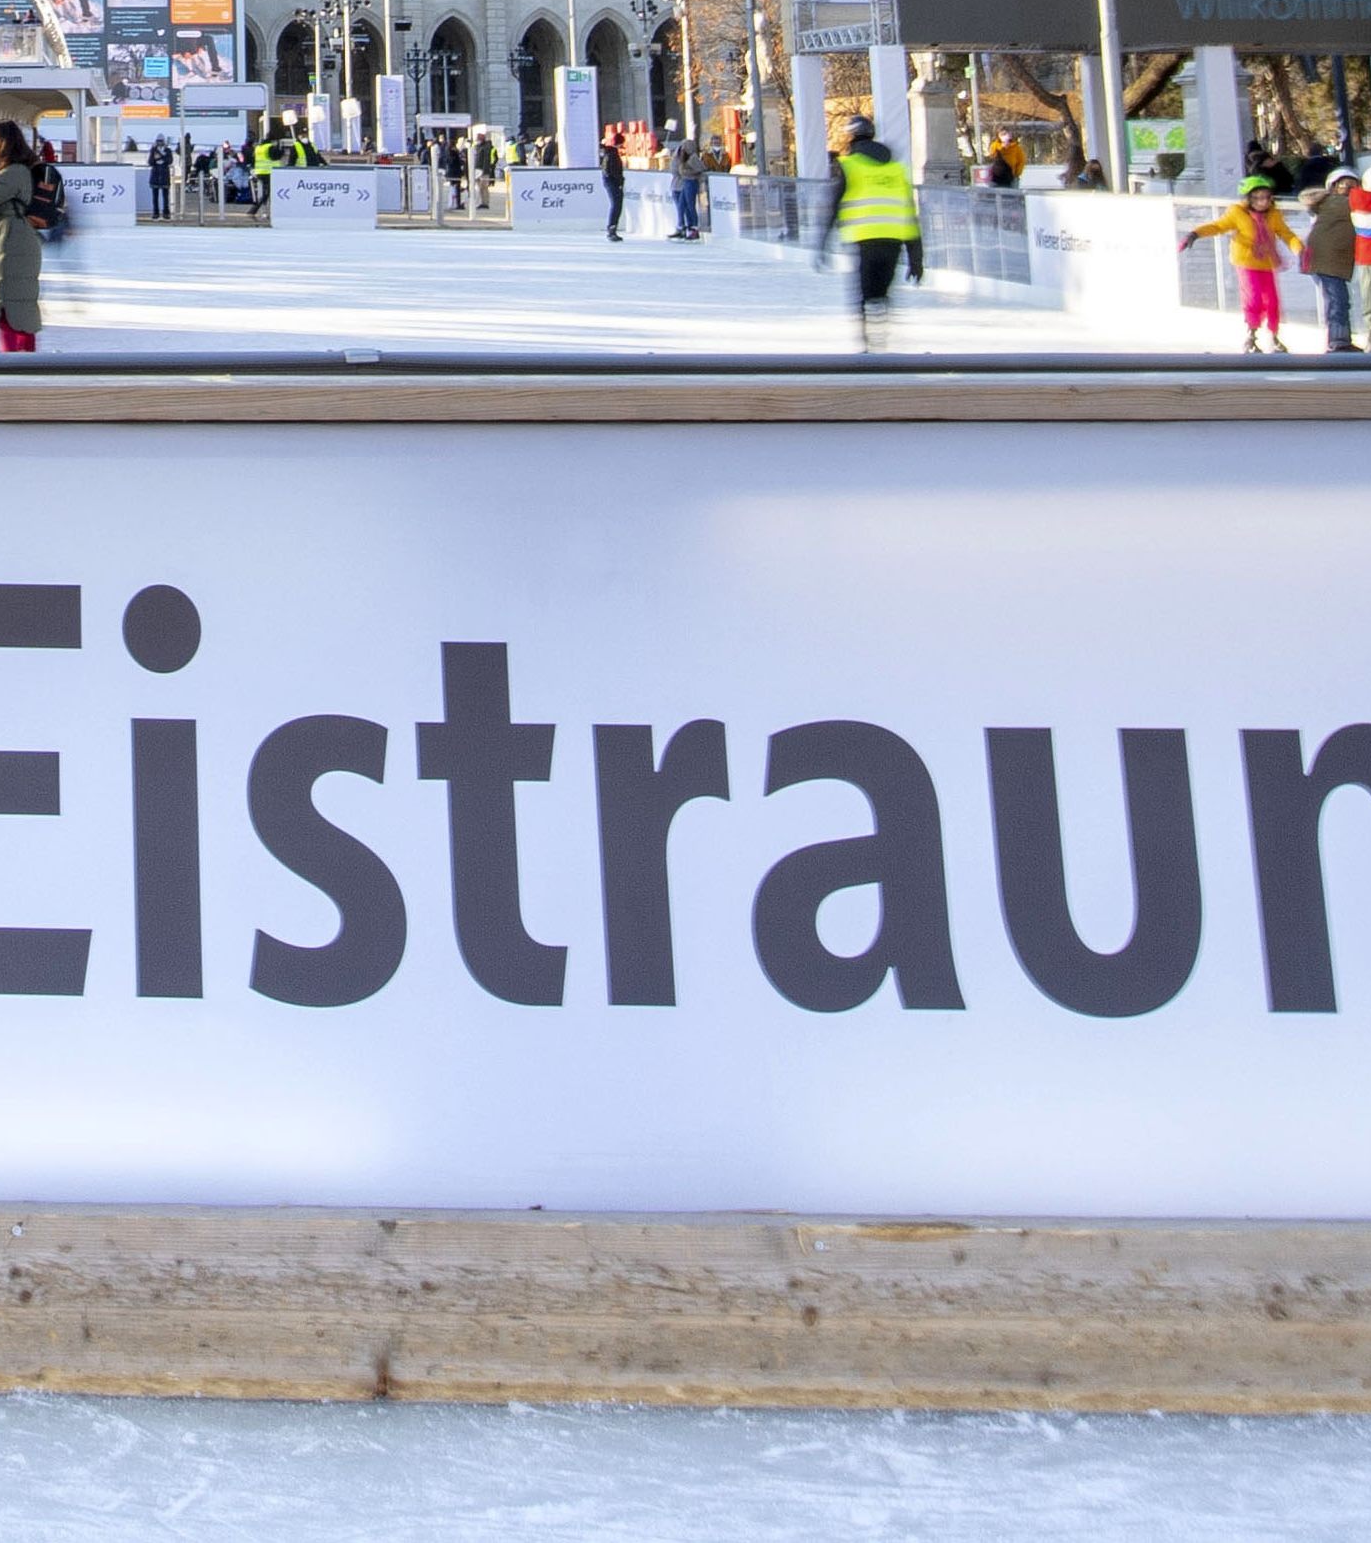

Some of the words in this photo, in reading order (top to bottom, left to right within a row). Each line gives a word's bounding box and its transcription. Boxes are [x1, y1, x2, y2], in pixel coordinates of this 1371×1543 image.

[62, 178, 105, 190] usgang
[297, 180, 350, 193] Ausgang
[541, 181, 594, 193] Ausgang
[82, 192, 105, 204] Exit
[312, 196, 335, 208] Exit
[541, 197, 564, 208] Exit
